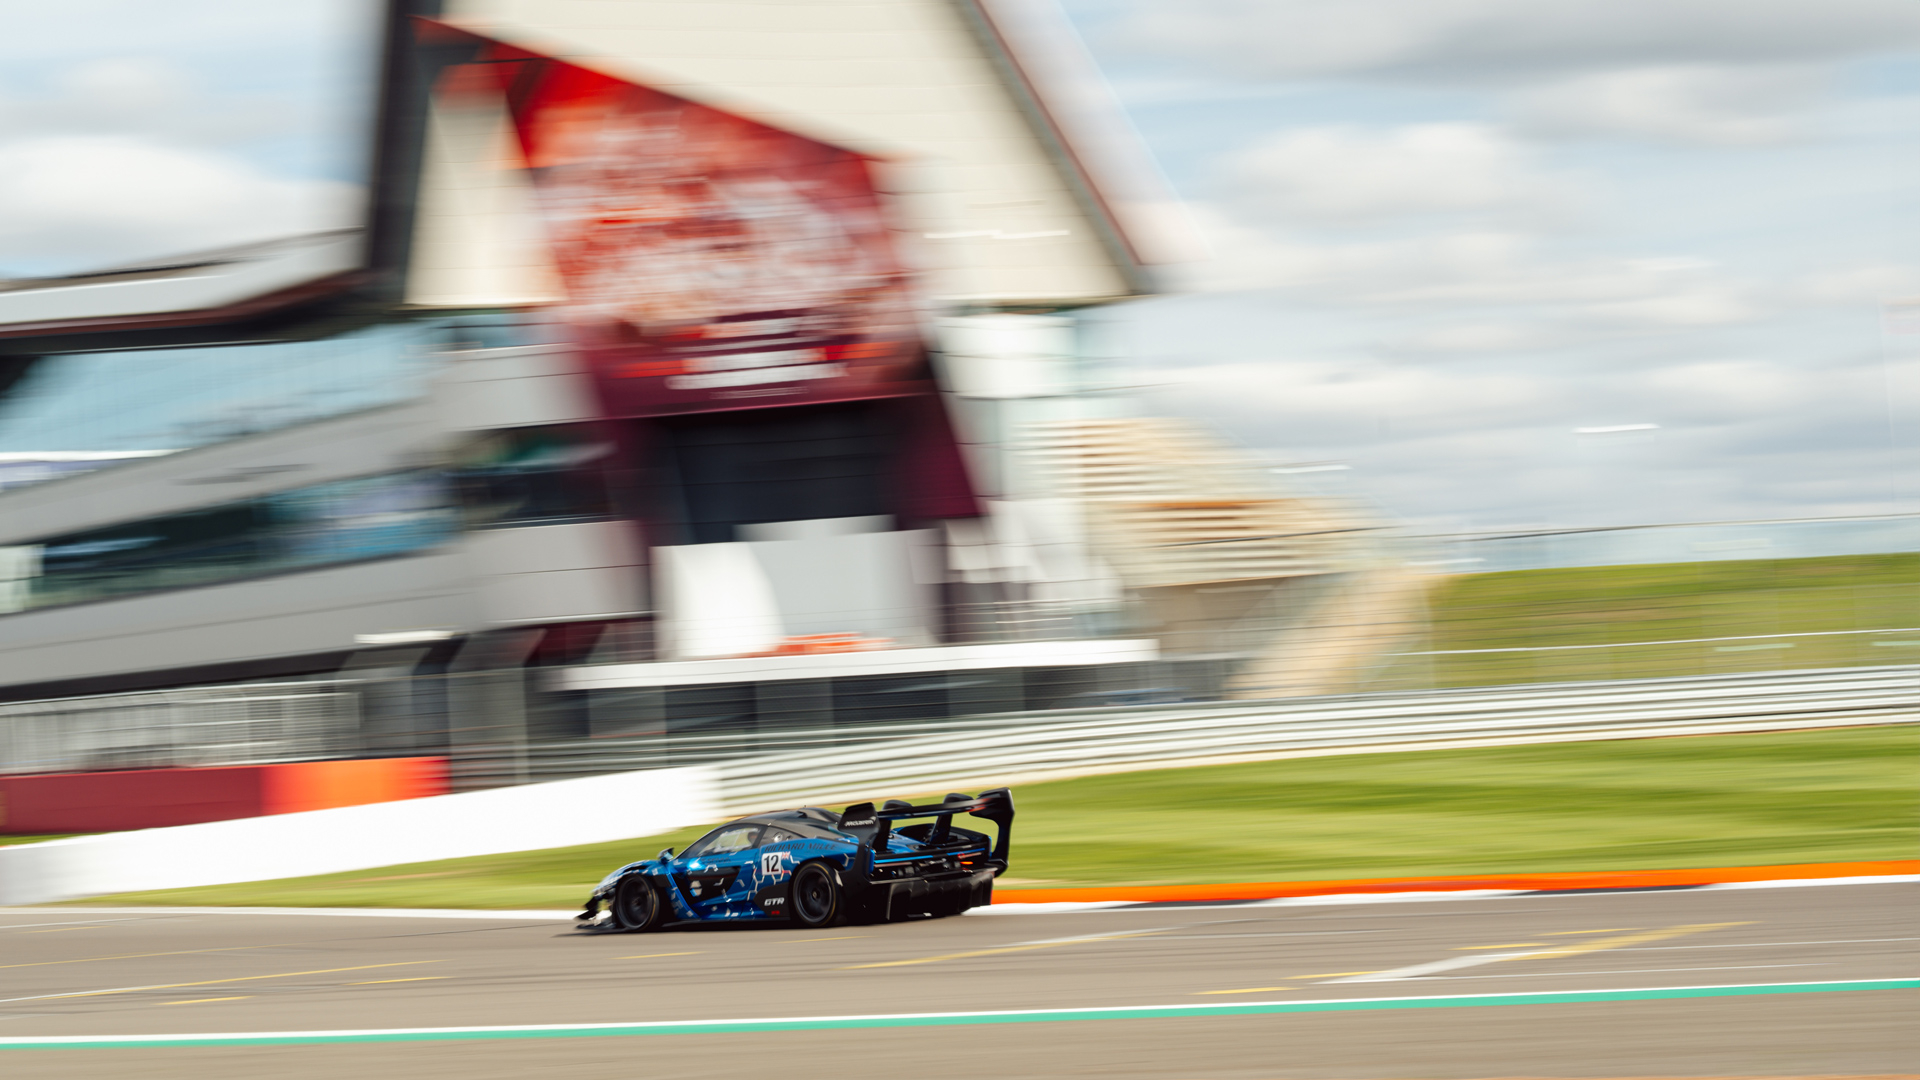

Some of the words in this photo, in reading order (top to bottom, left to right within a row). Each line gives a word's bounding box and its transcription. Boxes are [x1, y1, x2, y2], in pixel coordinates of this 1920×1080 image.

[764, 843, 805, 852] RICHARD
[807, 842, 836, 850] MILLE
[764, 855, 780, 873] 12
[764, 897, 785, 907] GTR
